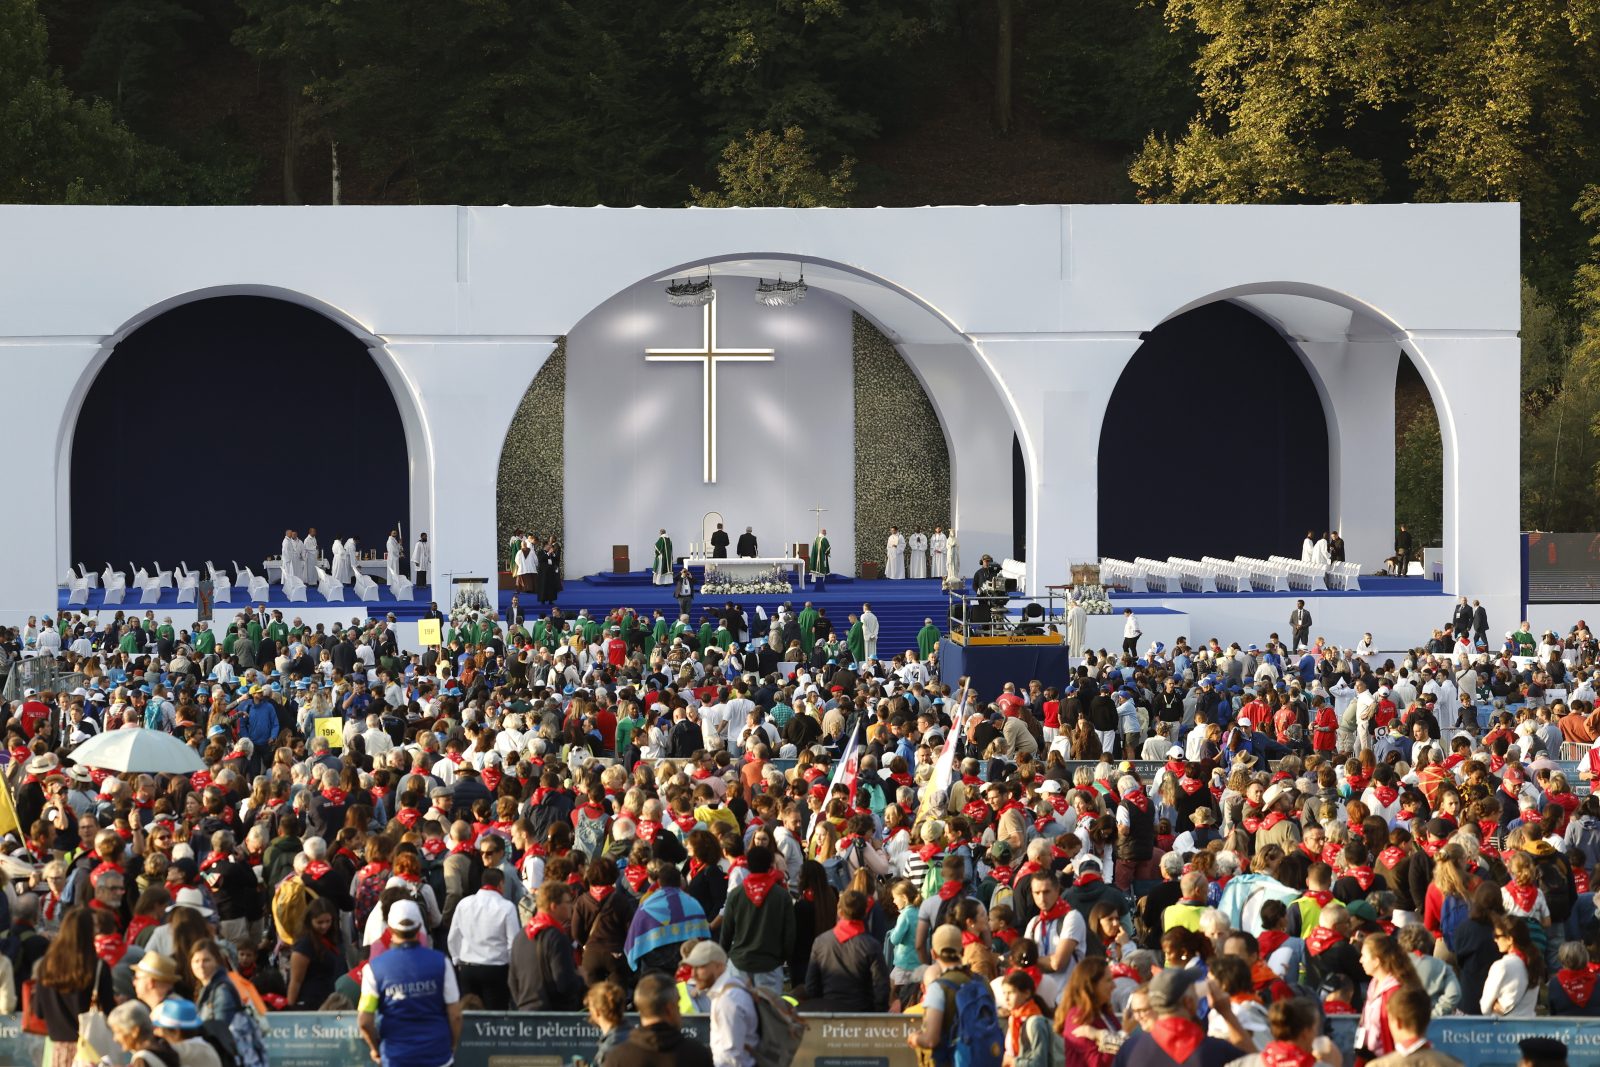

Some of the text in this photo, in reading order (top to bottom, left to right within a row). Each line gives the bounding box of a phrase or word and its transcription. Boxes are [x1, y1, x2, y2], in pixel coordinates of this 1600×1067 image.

[911, 671, 920, 681] 14
[294, 1023, 308, 1039] le
[475, 1021, 602, 1039] Vivre le pèlerina
[822, 1023, 861, 1038] Prier
[864, 1026, 898, 1038] avec
[1442, 1029, 1493, 1044] Rester
